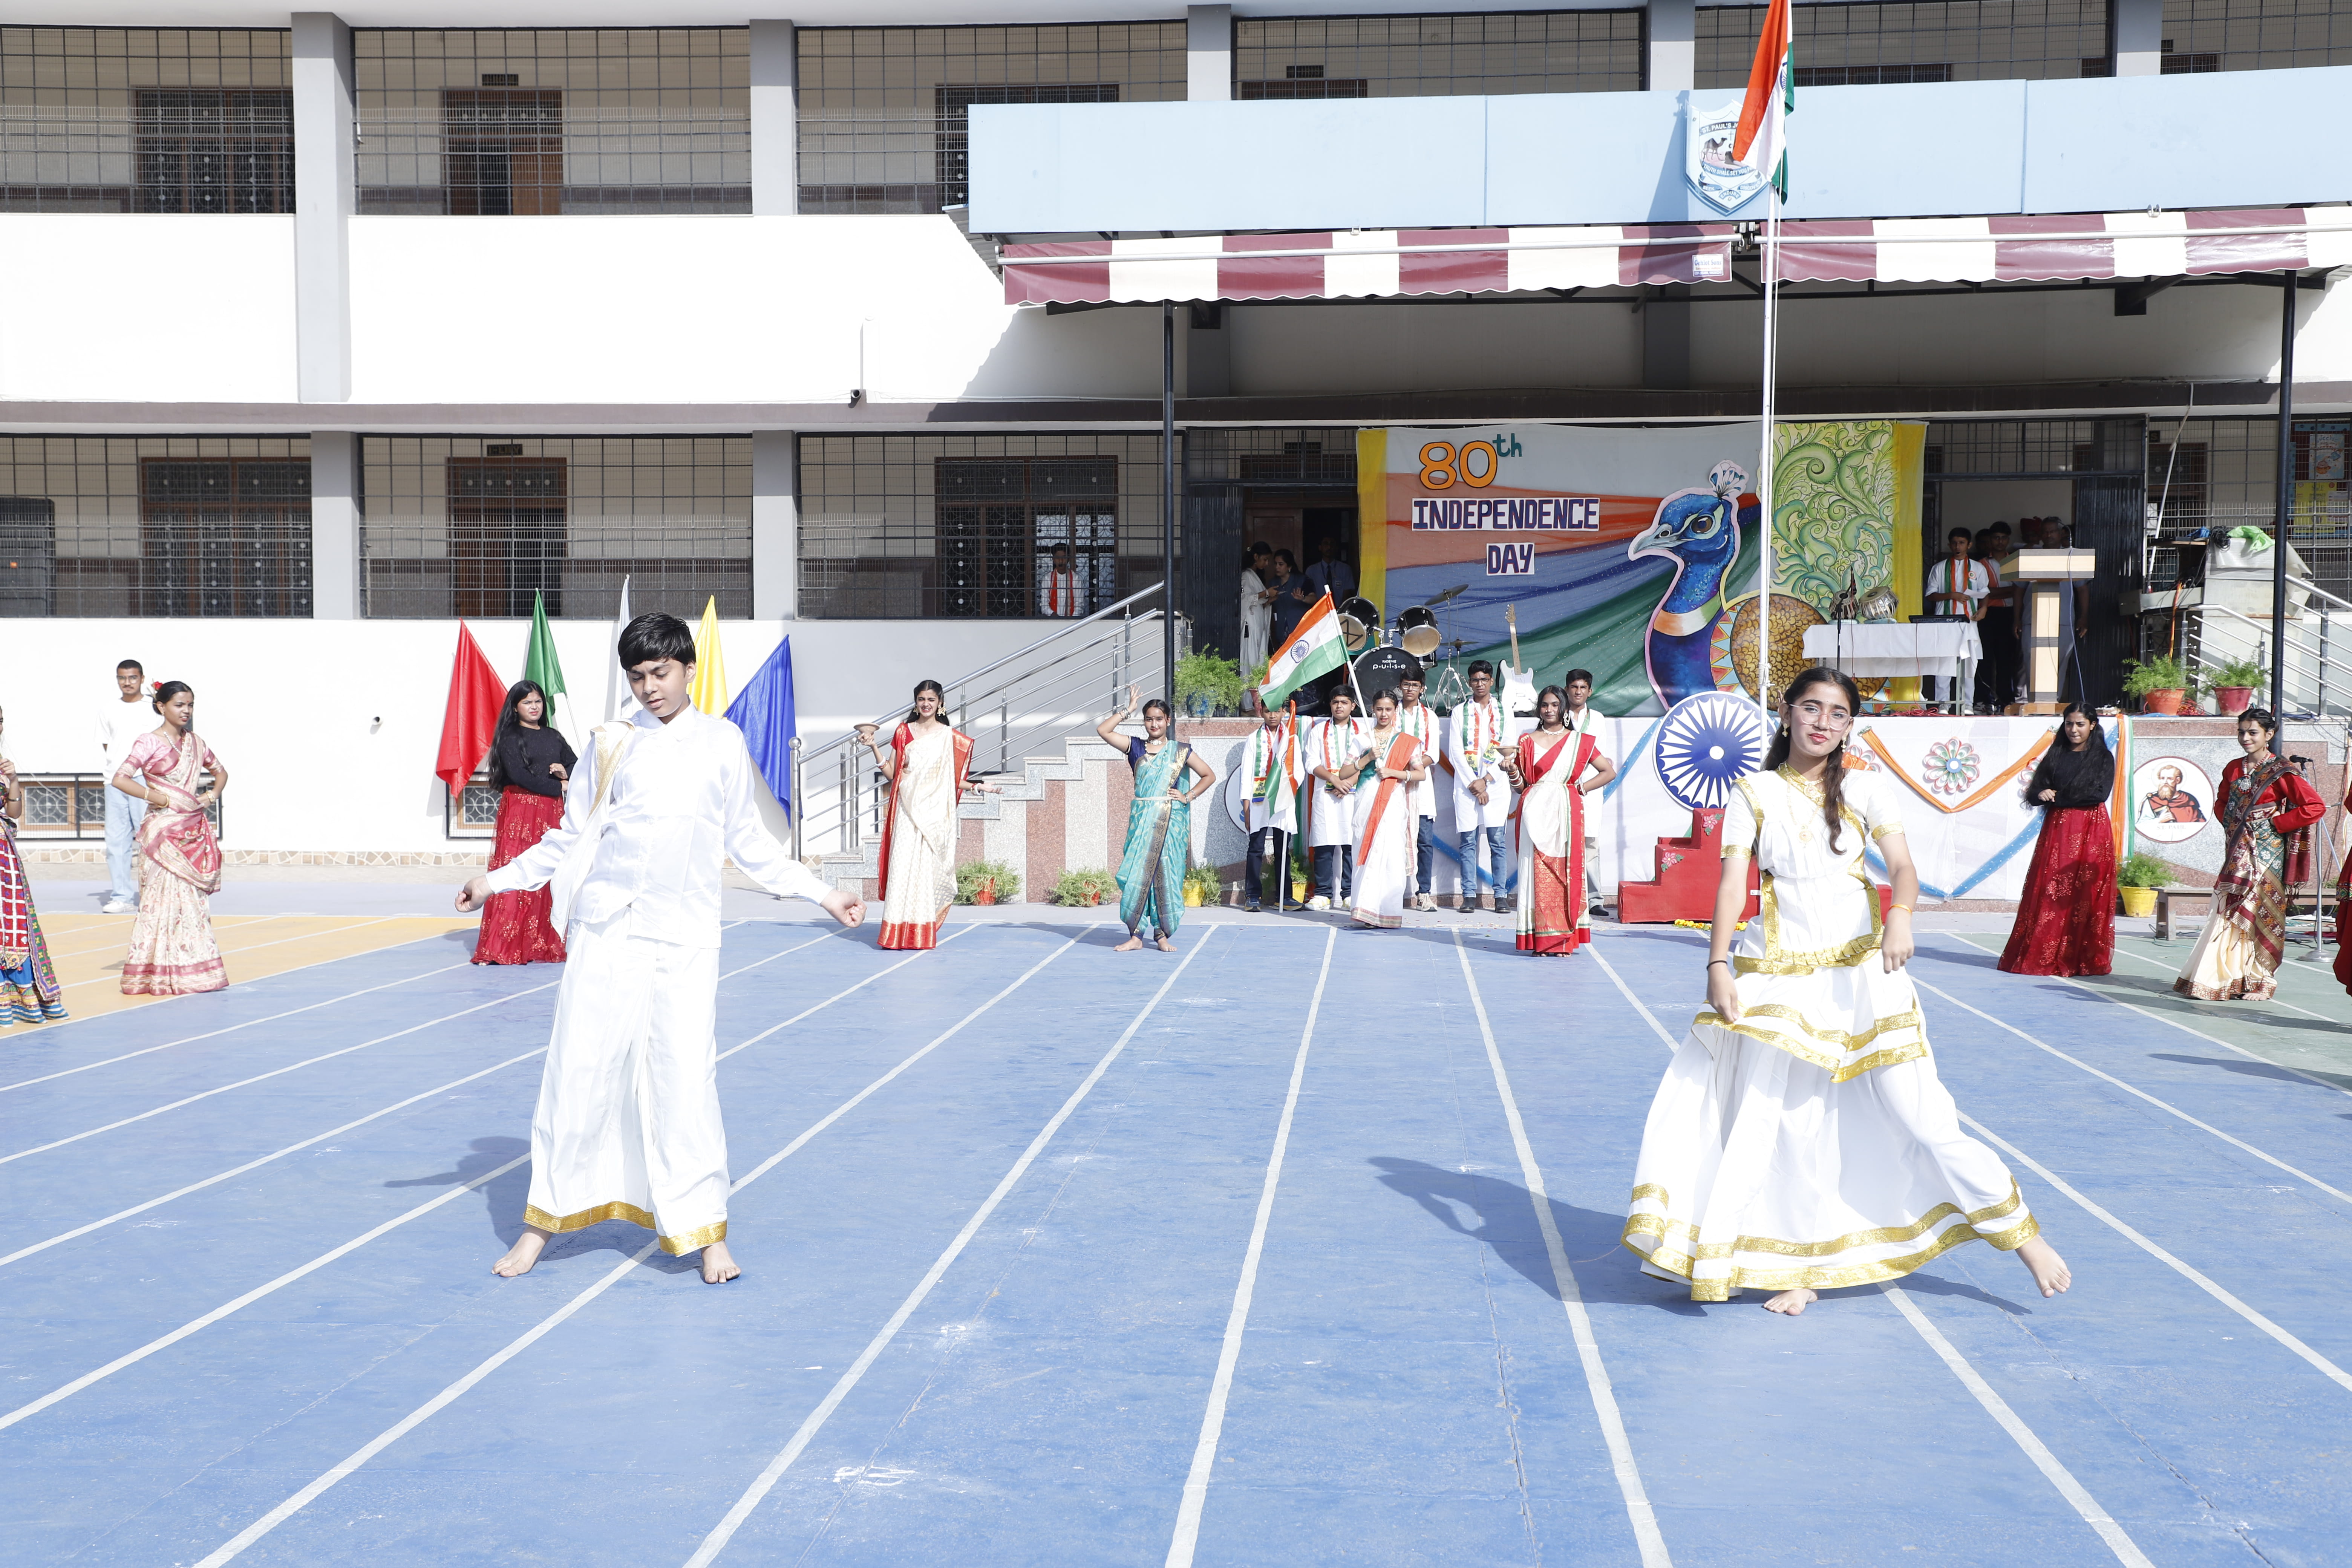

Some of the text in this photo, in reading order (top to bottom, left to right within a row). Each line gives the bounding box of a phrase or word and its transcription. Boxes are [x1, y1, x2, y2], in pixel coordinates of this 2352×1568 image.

[1703, 164, 1716, 173] TRUTH
[1419, 433, 1522, 490] 80th
[1413, 499, 1599, 529] INDEPENDENCE
[1488, 544, 1533, 574] DAY
